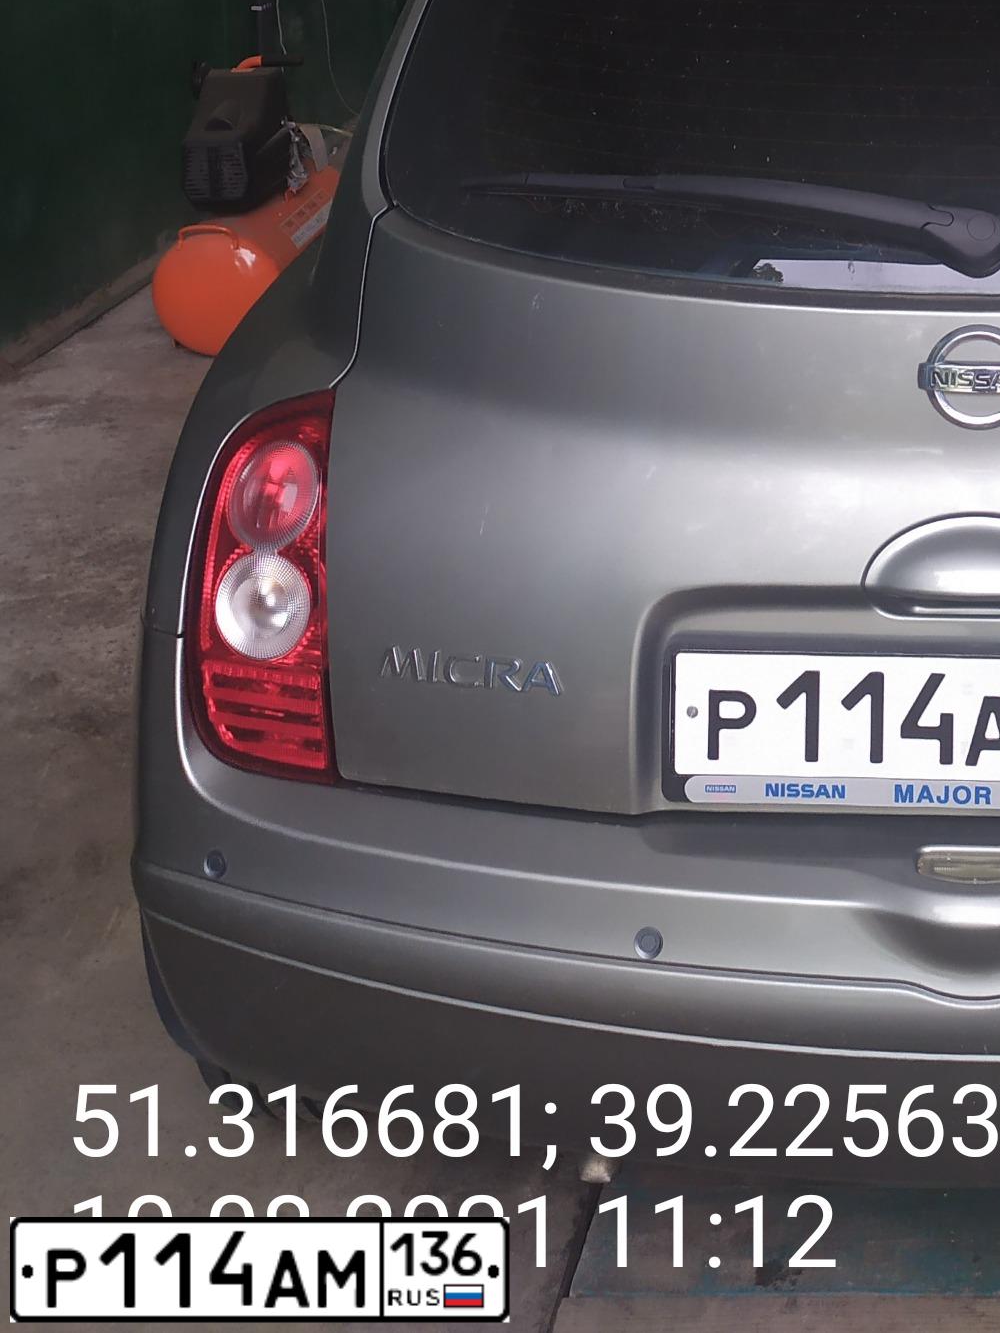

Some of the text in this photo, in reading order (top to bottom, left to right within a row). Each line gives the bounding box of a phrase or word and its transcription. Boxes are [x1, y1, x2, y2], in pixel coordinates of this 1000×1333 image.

[381, 644, 564, 696] MICRA
[706, 785, 736, 793] NISSAN
[765, 783, 846, 799] NISSAN
[894, 784, 992, 805] MAJOR
